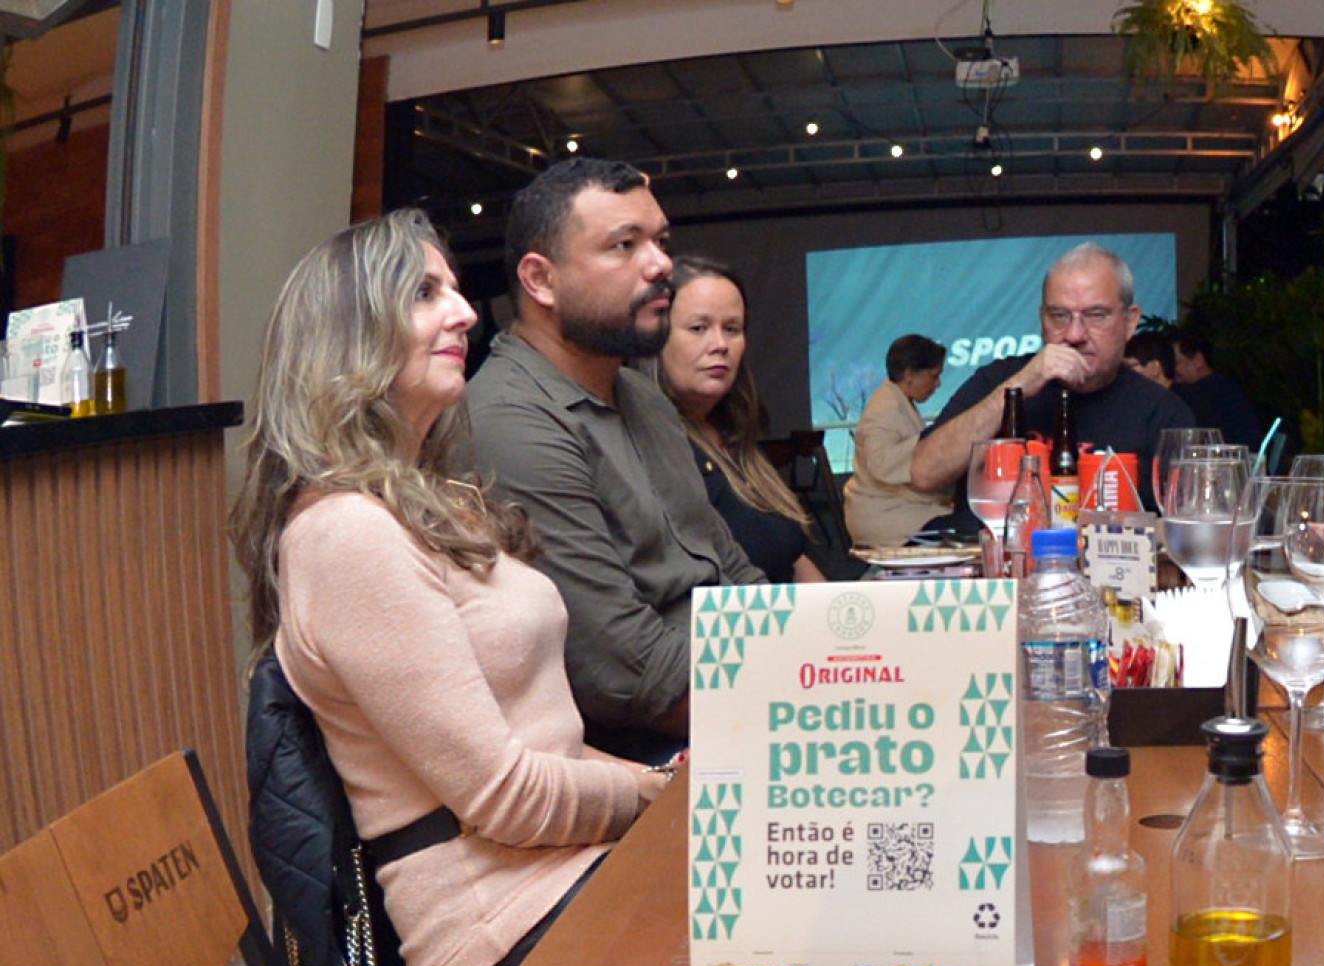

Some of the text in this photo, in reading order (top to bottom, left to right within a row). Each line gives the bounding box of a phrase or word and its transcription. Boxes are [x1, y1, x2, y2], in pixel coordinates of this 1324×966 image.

[800, 662, 904, 689] ORIGINAL
[768, 698, 935, 731] Pediu o
[768, 735, 934, 781] prato
[767, 783, 935, 808] Botecar?
[767, 821, 854, 842] Então é
[767, 844, 854, 865] hora de
[126, 840, 200, 911] SPATEN
[766, 868, 835, 889] votar!
